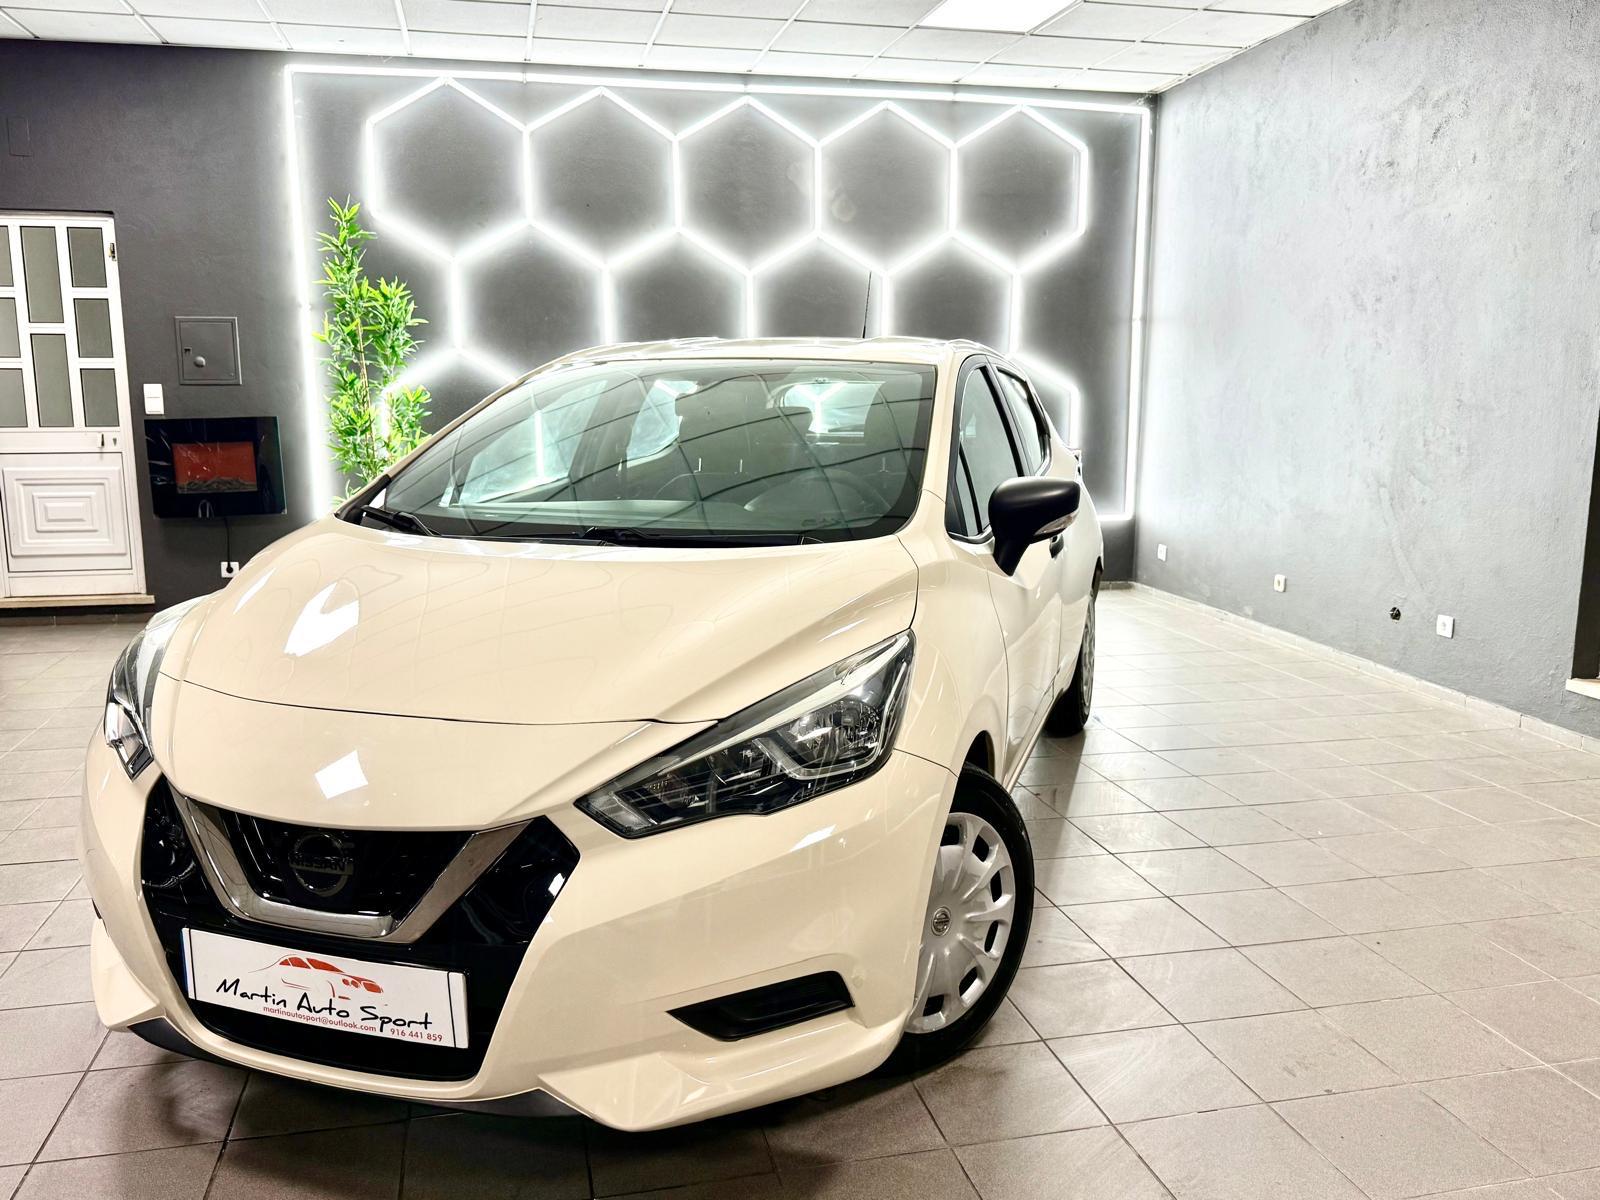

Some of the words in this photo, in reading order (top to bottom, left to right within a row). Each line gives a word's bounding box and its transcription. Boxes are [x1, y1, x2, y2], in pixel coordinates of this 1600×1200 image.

[216, 979, 287, 1008] Martin
[297, 992, 350, 1018] Auto
[360, 1006, 432, 1032] Sport
[263, 1006, 377, 1032] martinautosport@outlook.com
[390, 1028, 406, 1037] 916
[408, 1030, 423, 1040] 441
[426, 1032, 443, 1042] 859
